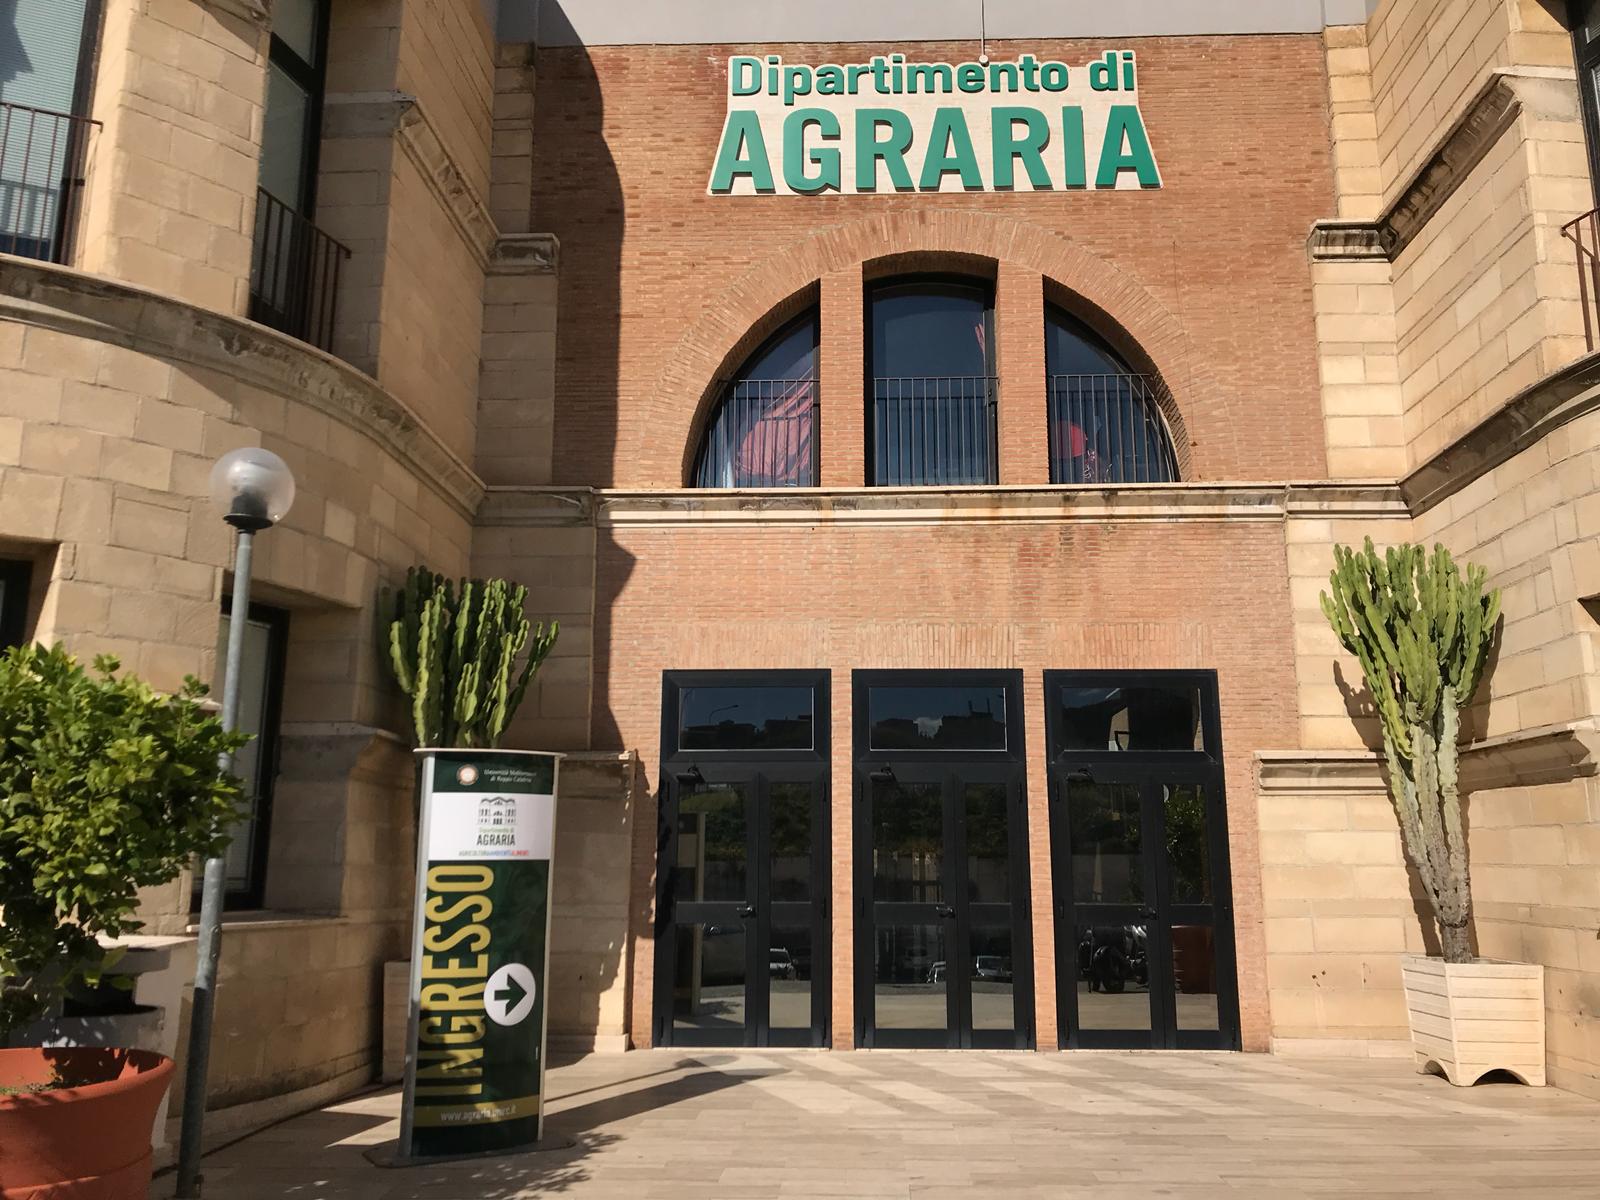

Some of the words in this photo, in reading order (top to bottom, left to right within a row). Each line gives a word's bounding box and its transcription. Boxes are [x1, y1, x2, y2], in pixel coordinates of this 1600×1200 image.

[731, 56, 1069, 105] Dipartimento
[1089, 51, 1135, 91] di
[710, 105, 1162, 195] AGRARIA
[476, 834, 516, 846] AGRARIA
[414, 865, 494, 1096] INGRESSO
